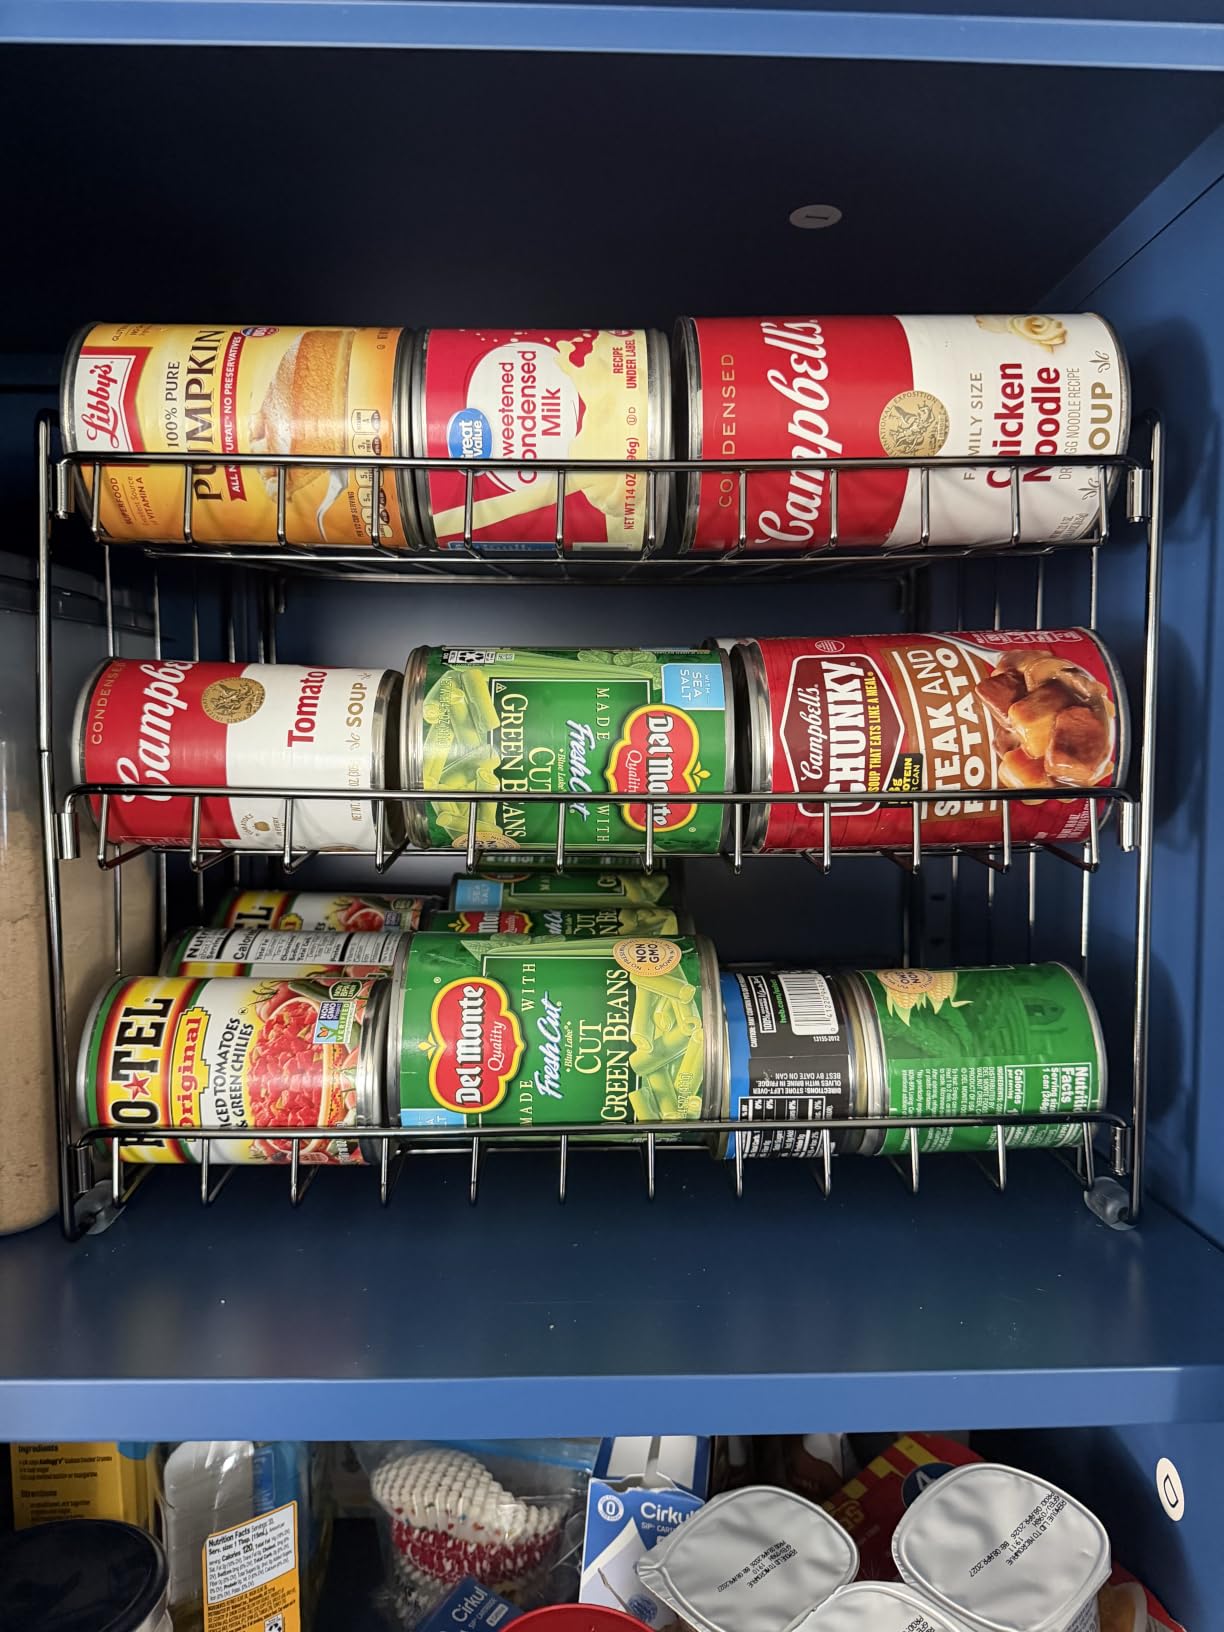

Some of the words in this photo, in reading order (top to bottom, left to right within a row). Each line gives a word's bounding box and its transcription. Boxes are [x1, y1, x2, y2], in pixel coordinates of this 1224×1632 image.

[224, 336, 242, 394] PRESERVATIVES
[613, 346, 624, 374] RECIPE
[626, 339, 637, 362] LABEL
[165, 360, 181, 401] PURE
[626, 363, 637, 389] UNDER
[970, 372, 983, 410] SIZE
[1066, 367, 1081, 398] RECIPE
[81, 361, 120, 449] Libby's
[224, 397, 233, 414] NO
[498, 362, 515, 457] weetened
[541, 387, 561, 437] Milk
[1065, 399, 1081, 440] NOODLE
[1088, 382, 1113, 453] OUP
[166, 406, 180, 449] 100%
[471, 420, 482, 457] Value
[719, 353, 736, 508] CODENSED
[755, 320, 843, 543] Campbell's
[963, 410, 983, 481] FMILY
[126, 476, 141, 500] Source
[135, 476, 145, 485] A
[232, 473, 241, 493] ALL
[626, 473, 637, 488] OZ
[626, 488, 636, 501] 14
[137, 486, 155, 520] VITAMIN
[624, 504, 635, 517] WT
[624, 517, 634, 530] NET
[680, 668, 692, 701] SALT
[692, 671, 703, 698] SEA
[864, 675, 879, 697] MEAL
[907, 649, 949, 695] AND
[287, 670, 328, 748] Tomato
[346, 682, 367, 728] SOUP
[596, 687, 610, 741] MADE
[868, 702, 881, 724] LIKE
[501, 693, 528, 772] GREEN
[566, 719, 595, 777] Fresh
[648, 713, 674, 755] Del
[800, 683, 828, 781] Campbell's
[820, 661, 866, 807] CHUNKY
[869, 724, 882, 746] EATS
[528, 747, 556, 792] CUT
[558, 753, 566, 772] Blue
[869, 746, 882, 770] THAT
[901, 757, 913, 792] OTEIN
[911, 764, 921, 785] CAN
[925, 702, 961, 817] STEAK
[868, 770, 881, 792] SOUP
[351, 812, 361, 821] NET
[501, 777, 528, 838] BANS
[596, 804, 610, 842] WITH
[637, 942, 647, 964] NON
[649, 942, 660, 964] GMO
[334, 984, 343, 997] NON
[521, 962, 536, 1012] WITH
[320, 1003, 329, 1019] NON
[327, 1003, 337, 1019] GMO
[337, 1003, 350, 1041] VERIFIED
[536, 991, 563, 1042] Cut
[603, 969, 630, 1043] BEANS
[456, 984, 485, 1067] Monte
[213, 1017, 240, 1097] TOMATOES
[233, 1022, 254, 1073] CHILIES
[488, 1020, 508, 1072] Quality
[565, 1046, 573, 1068] Blue
[574, 1019, 602, 1075] CUT
[455, 1069, 482, 1106] Del
[534, 1042, 562, 1100] Fresh
[601, 1049, 630, 1124] GREEN
[1013, 1069, 1023, 1104] Calories
[1041, 1075, 1050, 1090] can
[1050, 1067, 1060, 1099] Serving
[1060, 1067, 1073, 1104] Facts
[230, 1074, 246, 1117] GREEN
[520, 1079, 533, 1126] MADE
[968, 1093, 975, 1101] OF
[988, 1101, 995, 1109] BY
[1006, 1081, 1014, 1100] serving
[1049, 1100, 1058, 1112] size
[213, 1098, 230, 1128] ICED
[236, 1119, 248, 1128] &
[208, 1534, 234, 1548] Nutrition
[235, 1527, 251, 1538] Facts
[221, 1551, 242, 1562] Calories
[451, 1586, 489, 1625] Cirkul
